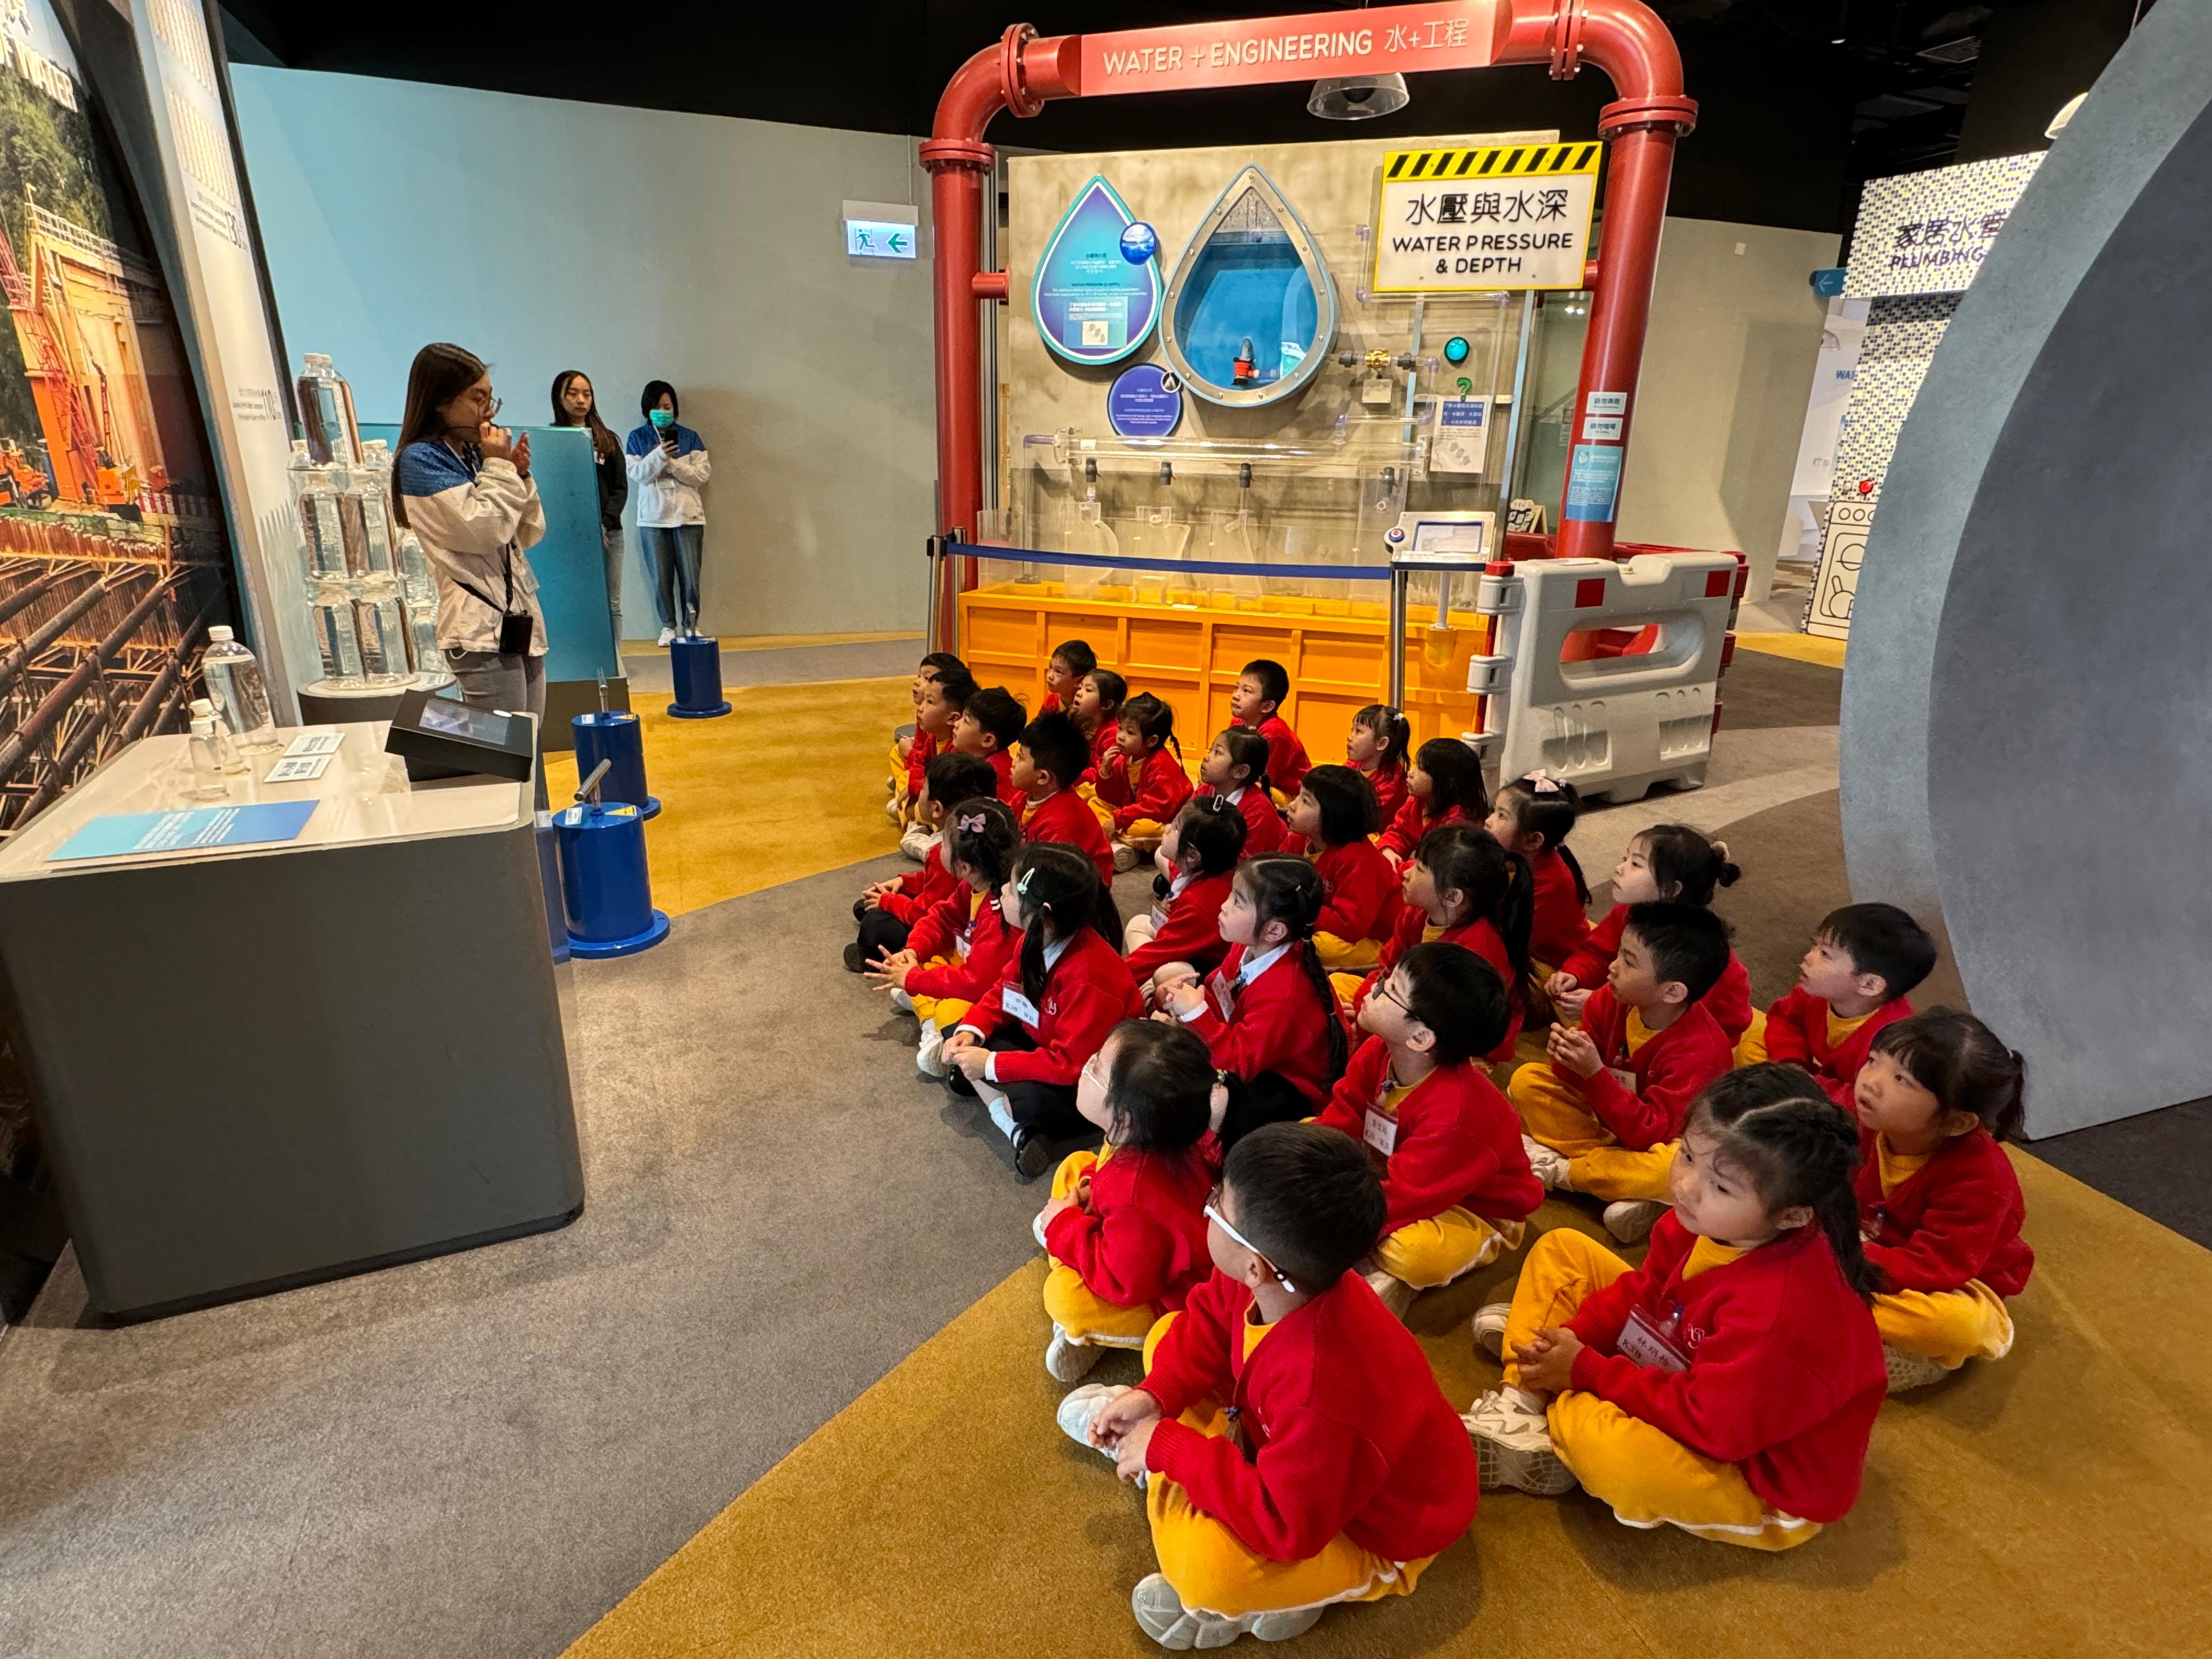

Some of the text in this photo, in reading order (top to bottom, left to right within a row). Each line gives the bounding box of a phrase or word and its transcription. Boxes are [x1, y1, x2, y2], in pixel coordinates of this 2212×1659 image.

[1103, 18, 1469, 75] WATER + ENGINEERING 水+工程
[1406, 189, 1568, 225] 水壓與水深
[1392, 233, 1573, 252] WATER PRESSURE
[1435, 256, 1522, 274] & DEPTH
[1888, 246, 1985, 271] PLUMBING
